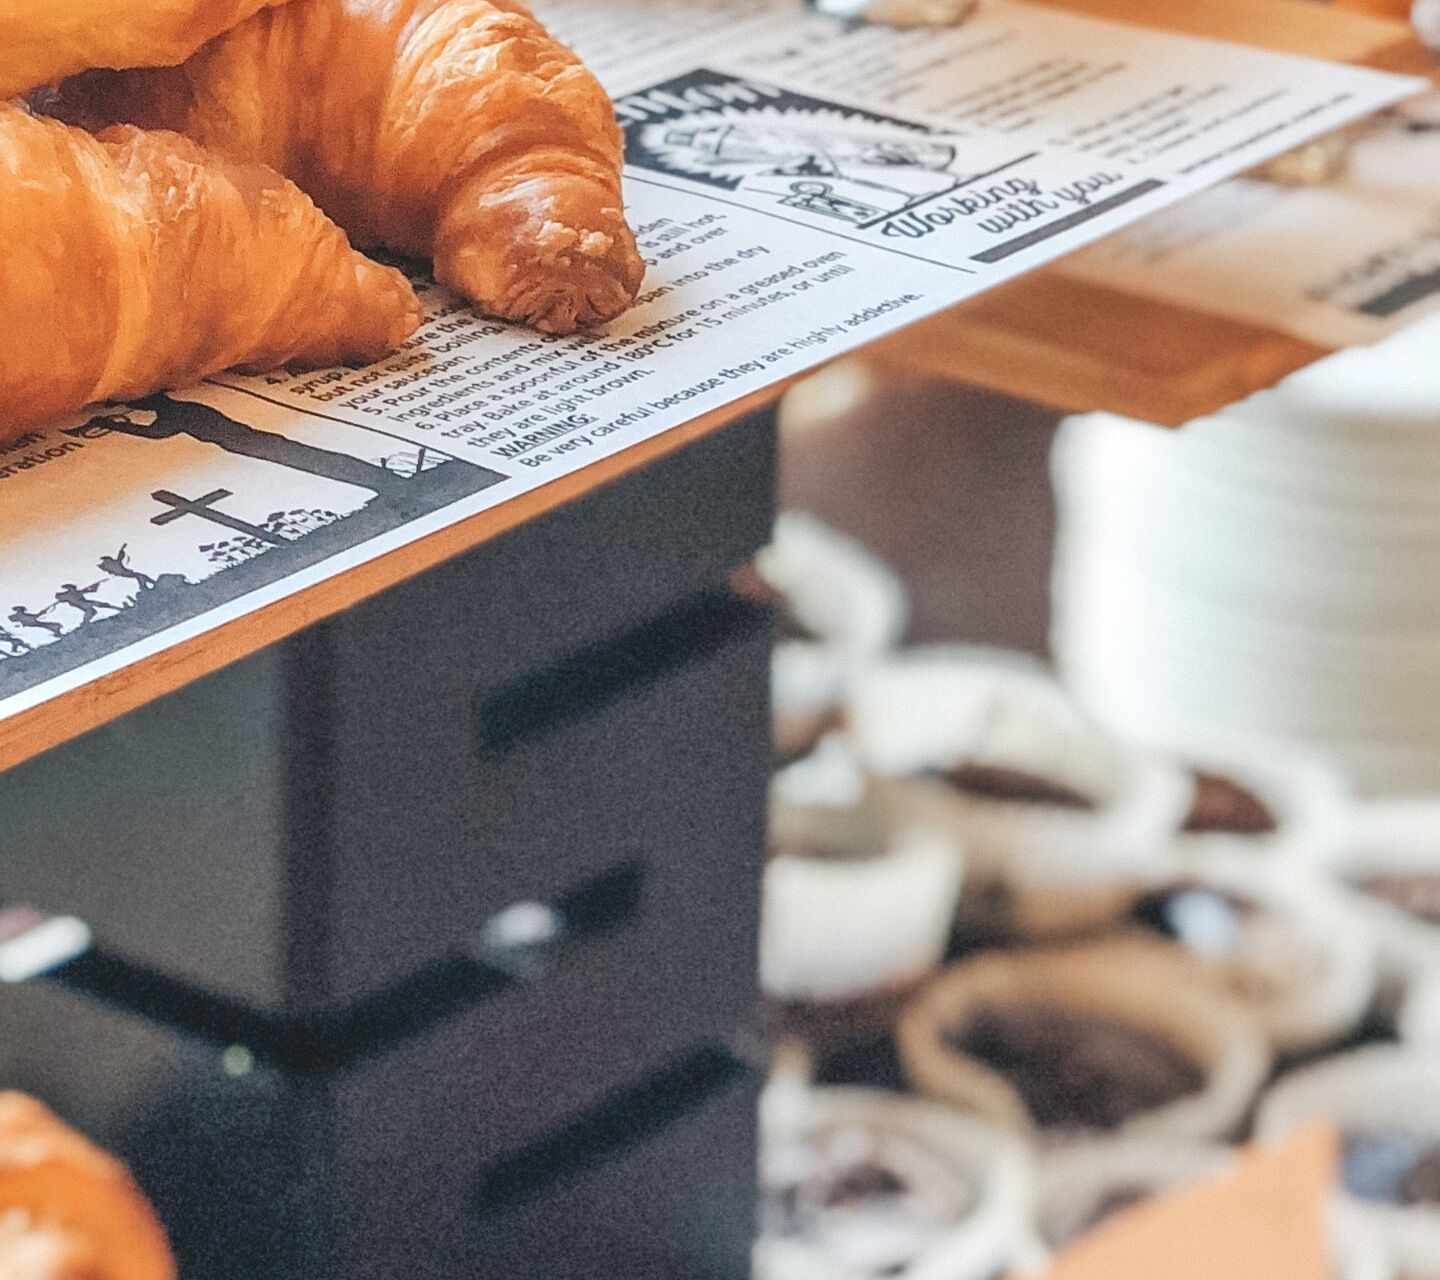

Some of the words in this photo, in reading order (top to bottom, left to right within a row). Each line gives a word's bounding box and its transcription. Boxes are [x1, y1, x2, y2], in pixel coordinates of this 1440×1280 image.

[881, 176, 1042, 238] Working
[977, 199, 1059, 234] with
[656, 243, 691, 258] and
[691, 227, 728, 243] over
[363, 407, 389, 415] 5.
[383, 387, 430, 406] Pour
[429, 375, 466, 387] the
[465, 338, 555, 374] contents
[672, 272, 709, 286] into
[705, 259, 739, 270] the
[738, 246, 770, 258] dry
[434, 401, 488, 421] Place
[502, 361, 581, 394] spoonful
[581, 351, 603, 361] of
[599, 339, 636, 351] the
[633, 310, 701, 338] mixture
[700, 300, 727, 309] on
[739, 266, 804, 294] greased
[803, 252, 846, 267] oven
[436, 319, 472, 332] the
[441, 421, 486, 438] tray.
[482, 401, 534, 420] Bake
[533, 391, 557, 400] at
[560, 362, 621, 390] around
[665, 329, 697, 341] for
[696, 318, 722, 328] 15
[721, 292, 796, 320] minutes,
[792, 281, 813, 290] or
[813, 265, 854, 282] until
[312, 387, 354, 401] but
[350, 372, 388, 387] not
[339, 389, 383, 409] your
[384, 356, 475, 389] saucepan.
[494, 364, 531, 381] and
[530, 351, 566, 364] mix
[519, 455, 551, 467] Be
[549, 436, 593, 454] very
[591, 407, 654, 436] careful
[647, 379, 724, 409] because
[719, 361, 765, 378] they
[762, 349, 793, 362] are
[786, 325, 848, 349] highly
[844, 295, 924, 326] addictive.
[468, 428, 516, 447] they
[513, 415, 547, 428] are
[540, 395, 592, 415] light
[583, 370, 655, 396] brown.
[490, 414, 599, 459] WARNING:
